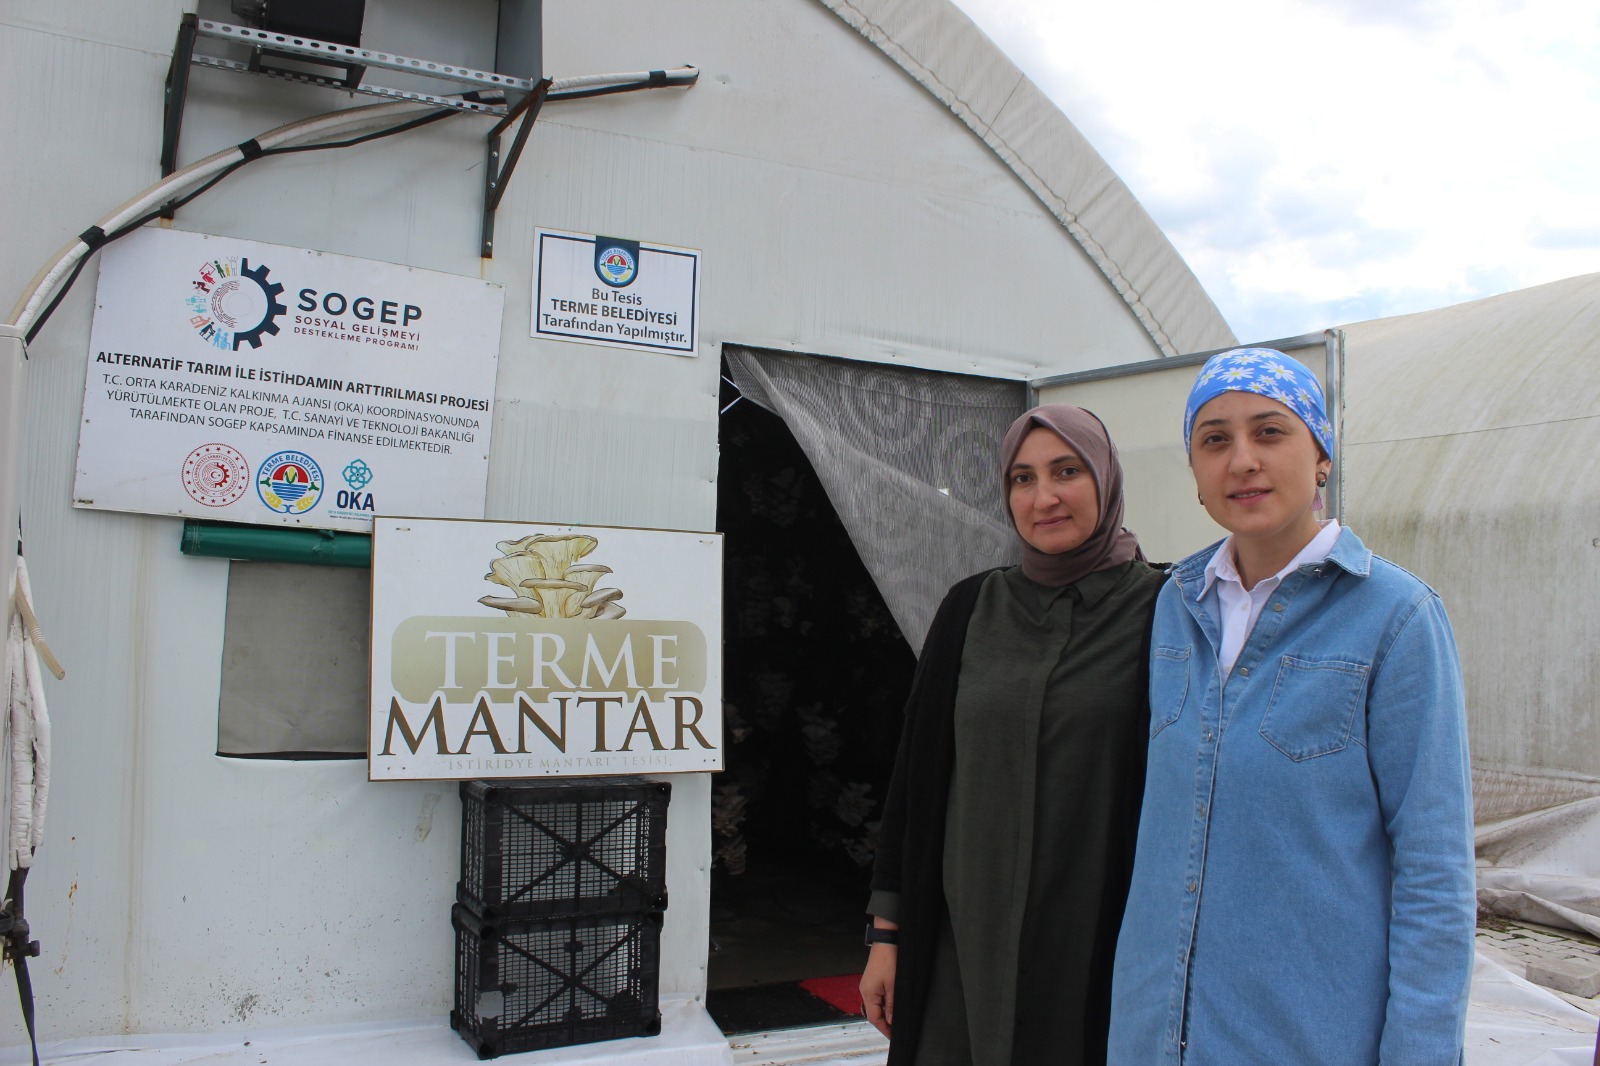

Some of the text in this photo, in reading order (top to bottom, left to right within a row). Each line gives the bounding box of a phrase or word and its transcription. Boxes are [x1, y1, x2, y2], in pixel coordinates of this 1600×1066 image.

[297, 288, 422, 327] SOGEP
[551, 299, 677, 326] TERME BELEDİYESİ
[592, 288, 642, 306] Bu Tesis
[294, 326, 419, 351] DESTEKLEME PROGRAMI
[295, 315, 420, 342] SOSYAL GELİŞMEYİ
[543, 313, 687, 344] Tarafından Yapılmıştır.
[96, 351, 489, 412] ALTERNATİF TARIM İLE İSTİHDAMIN ARTTIRILMASI PROJESİ
[102, 373, 480, 429] T.C. ORTA KARADENİZ KALKINMA AJANSI (OKA) KOORDİNASYONUNDA
[106, 389, 474, 443] YÜRÜTÜLMEKTE OLAN PROJE, T.C. SANAYİ VE TEKNOLOJİ BAKANLIĞI
[130, 407, 453, 455] TARAFINDAN SOGEP KAPSAMINDA FİNANSE EDİLMEKTEDİR.
[262, 455, 283, 476] TERME
[285, 454, 320, 482] BELEDİYESİ
[336, 490, 375, 511] OKA
[424, 630, 680, 689] TERME
[377, 696, 717, 756] MANTAR
